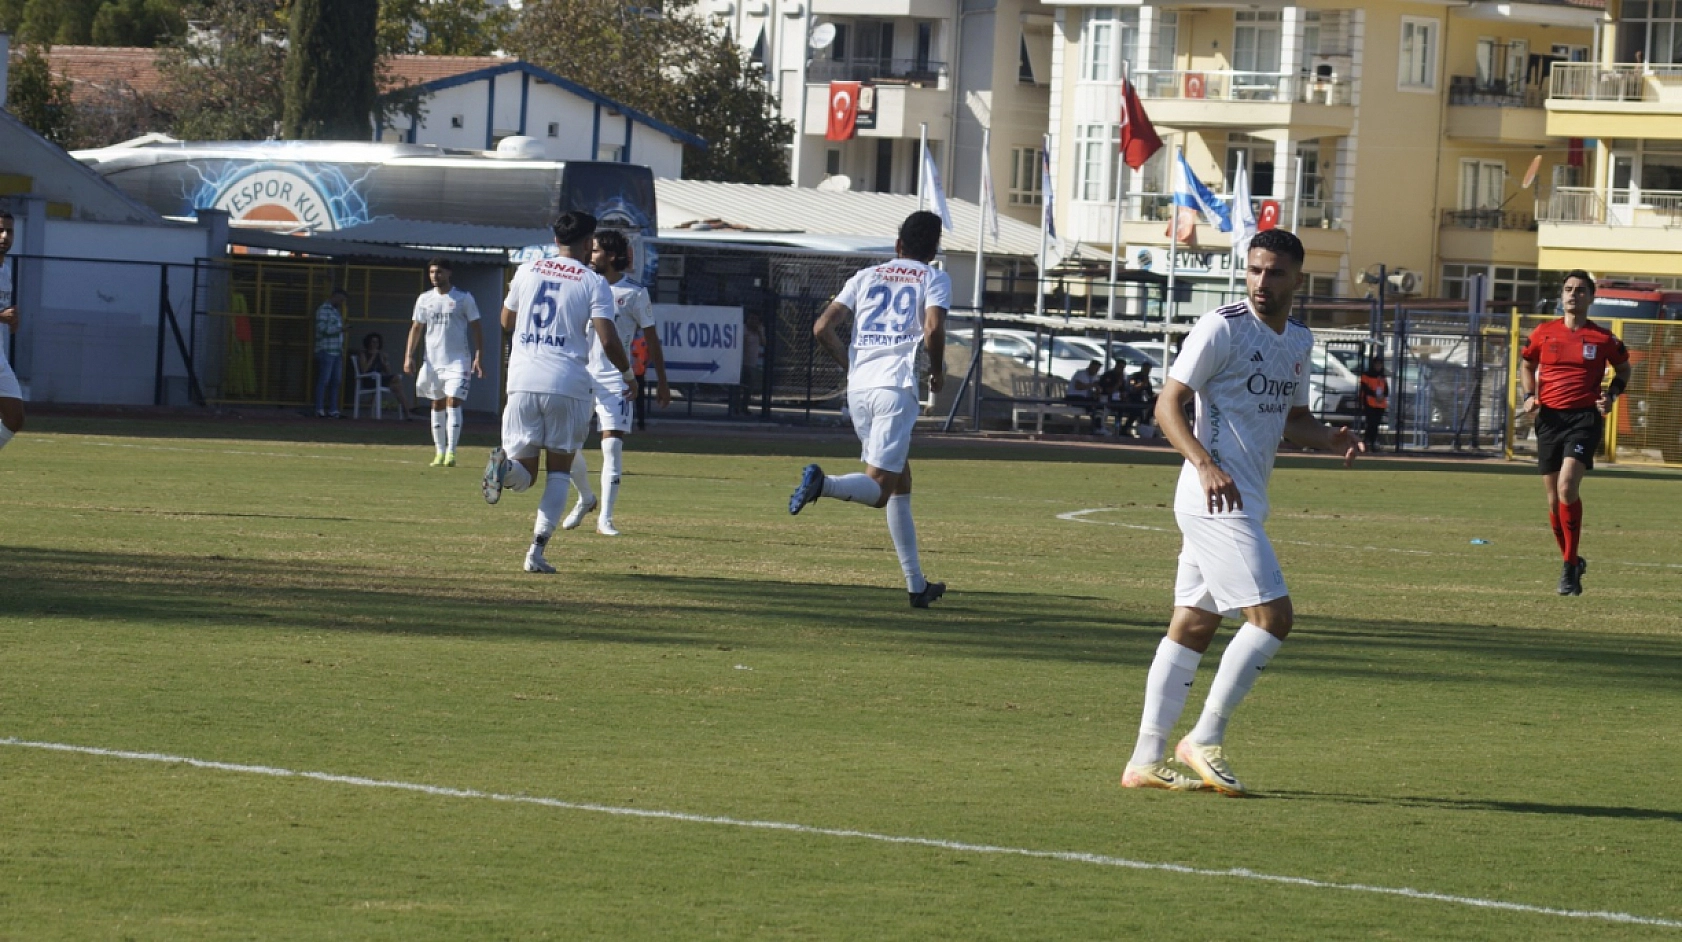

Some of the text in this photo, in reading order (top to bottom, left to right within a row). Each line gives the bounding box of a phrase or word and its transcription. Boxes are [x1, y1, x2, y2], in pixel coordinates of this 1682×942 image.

[534, 260, 586, 274] ESNAF
[532, 280, 562, 328] 5
[861, 285, 917, 332] 29
[687, 322, 737, 350] ODASI
